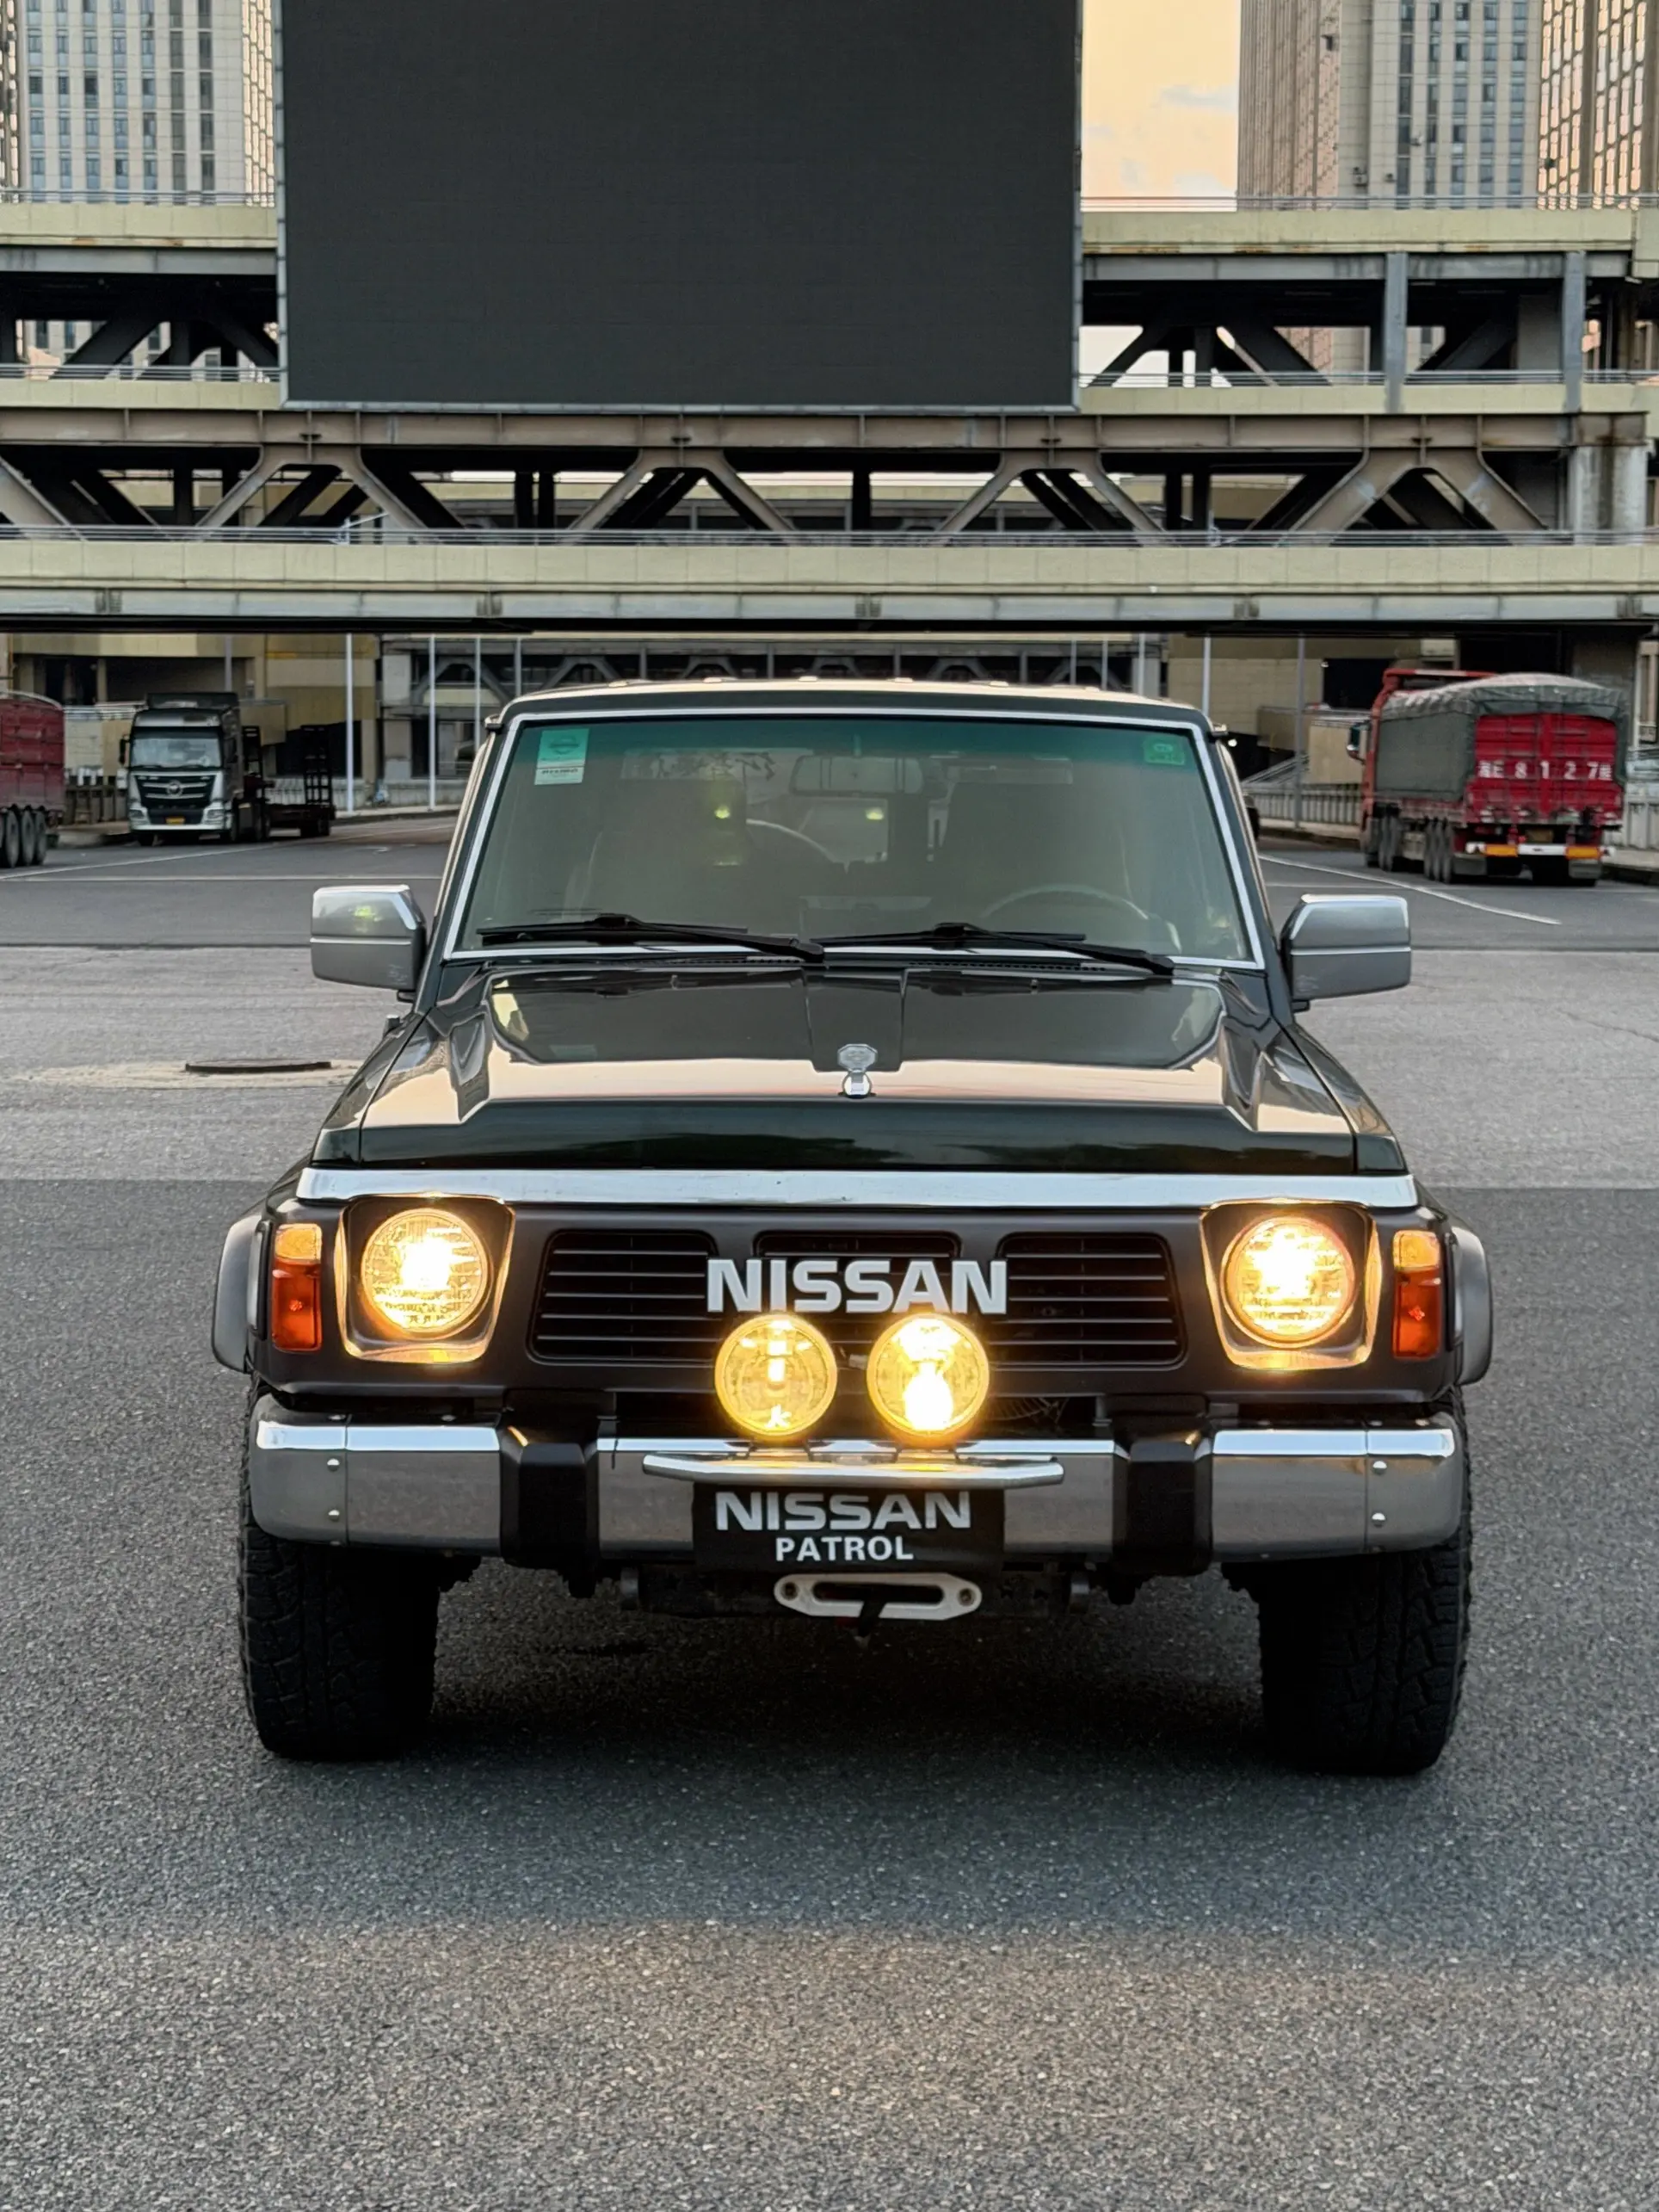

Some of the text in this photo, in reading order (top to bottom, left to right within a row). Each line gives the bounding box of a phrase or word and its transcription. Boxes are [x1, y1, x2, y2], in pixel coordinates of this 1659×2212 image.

[706, 1259, 1007, 1314] NISSAN
[716, 1491, 971, 1530] NISSAN
[776, 1536, 914, 1561] PATROL
